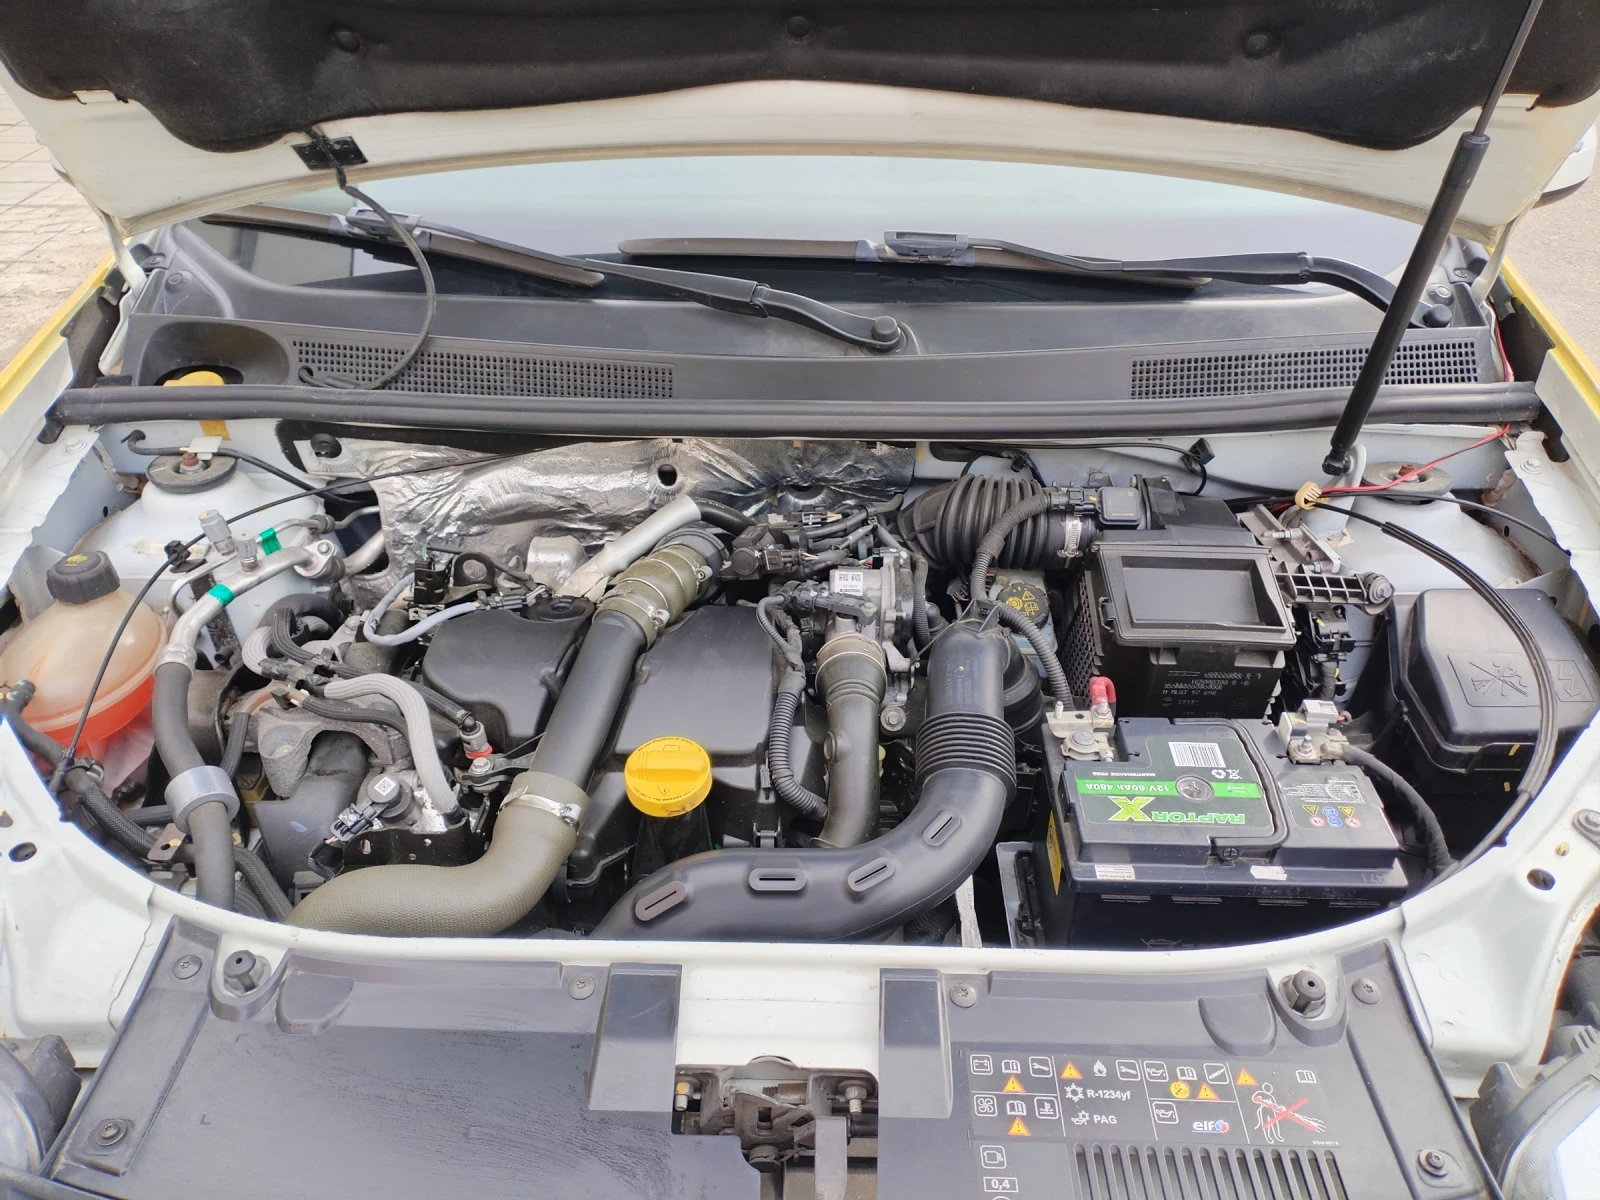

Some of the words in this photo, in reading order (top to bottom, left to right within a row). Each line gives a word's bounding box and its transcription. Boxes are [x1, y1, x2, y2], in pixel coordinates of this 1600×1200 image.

[1085, 782, 1113, 791] 480A
[1116, 783, 1146, 792] 60Ah
[1149, 784, 1170, 792] 12V
[1108, 796, 1156, 822] X
[1151, 811, 1246, 825] RAPTOR
[1086, 1089, 1131, 1101] R-1234yf
[1093, 1114, 1118, 1125] PAG
[1192, 1120, 1215, 1131] elf
[991, 1178, 1011, 1191] 0,4
